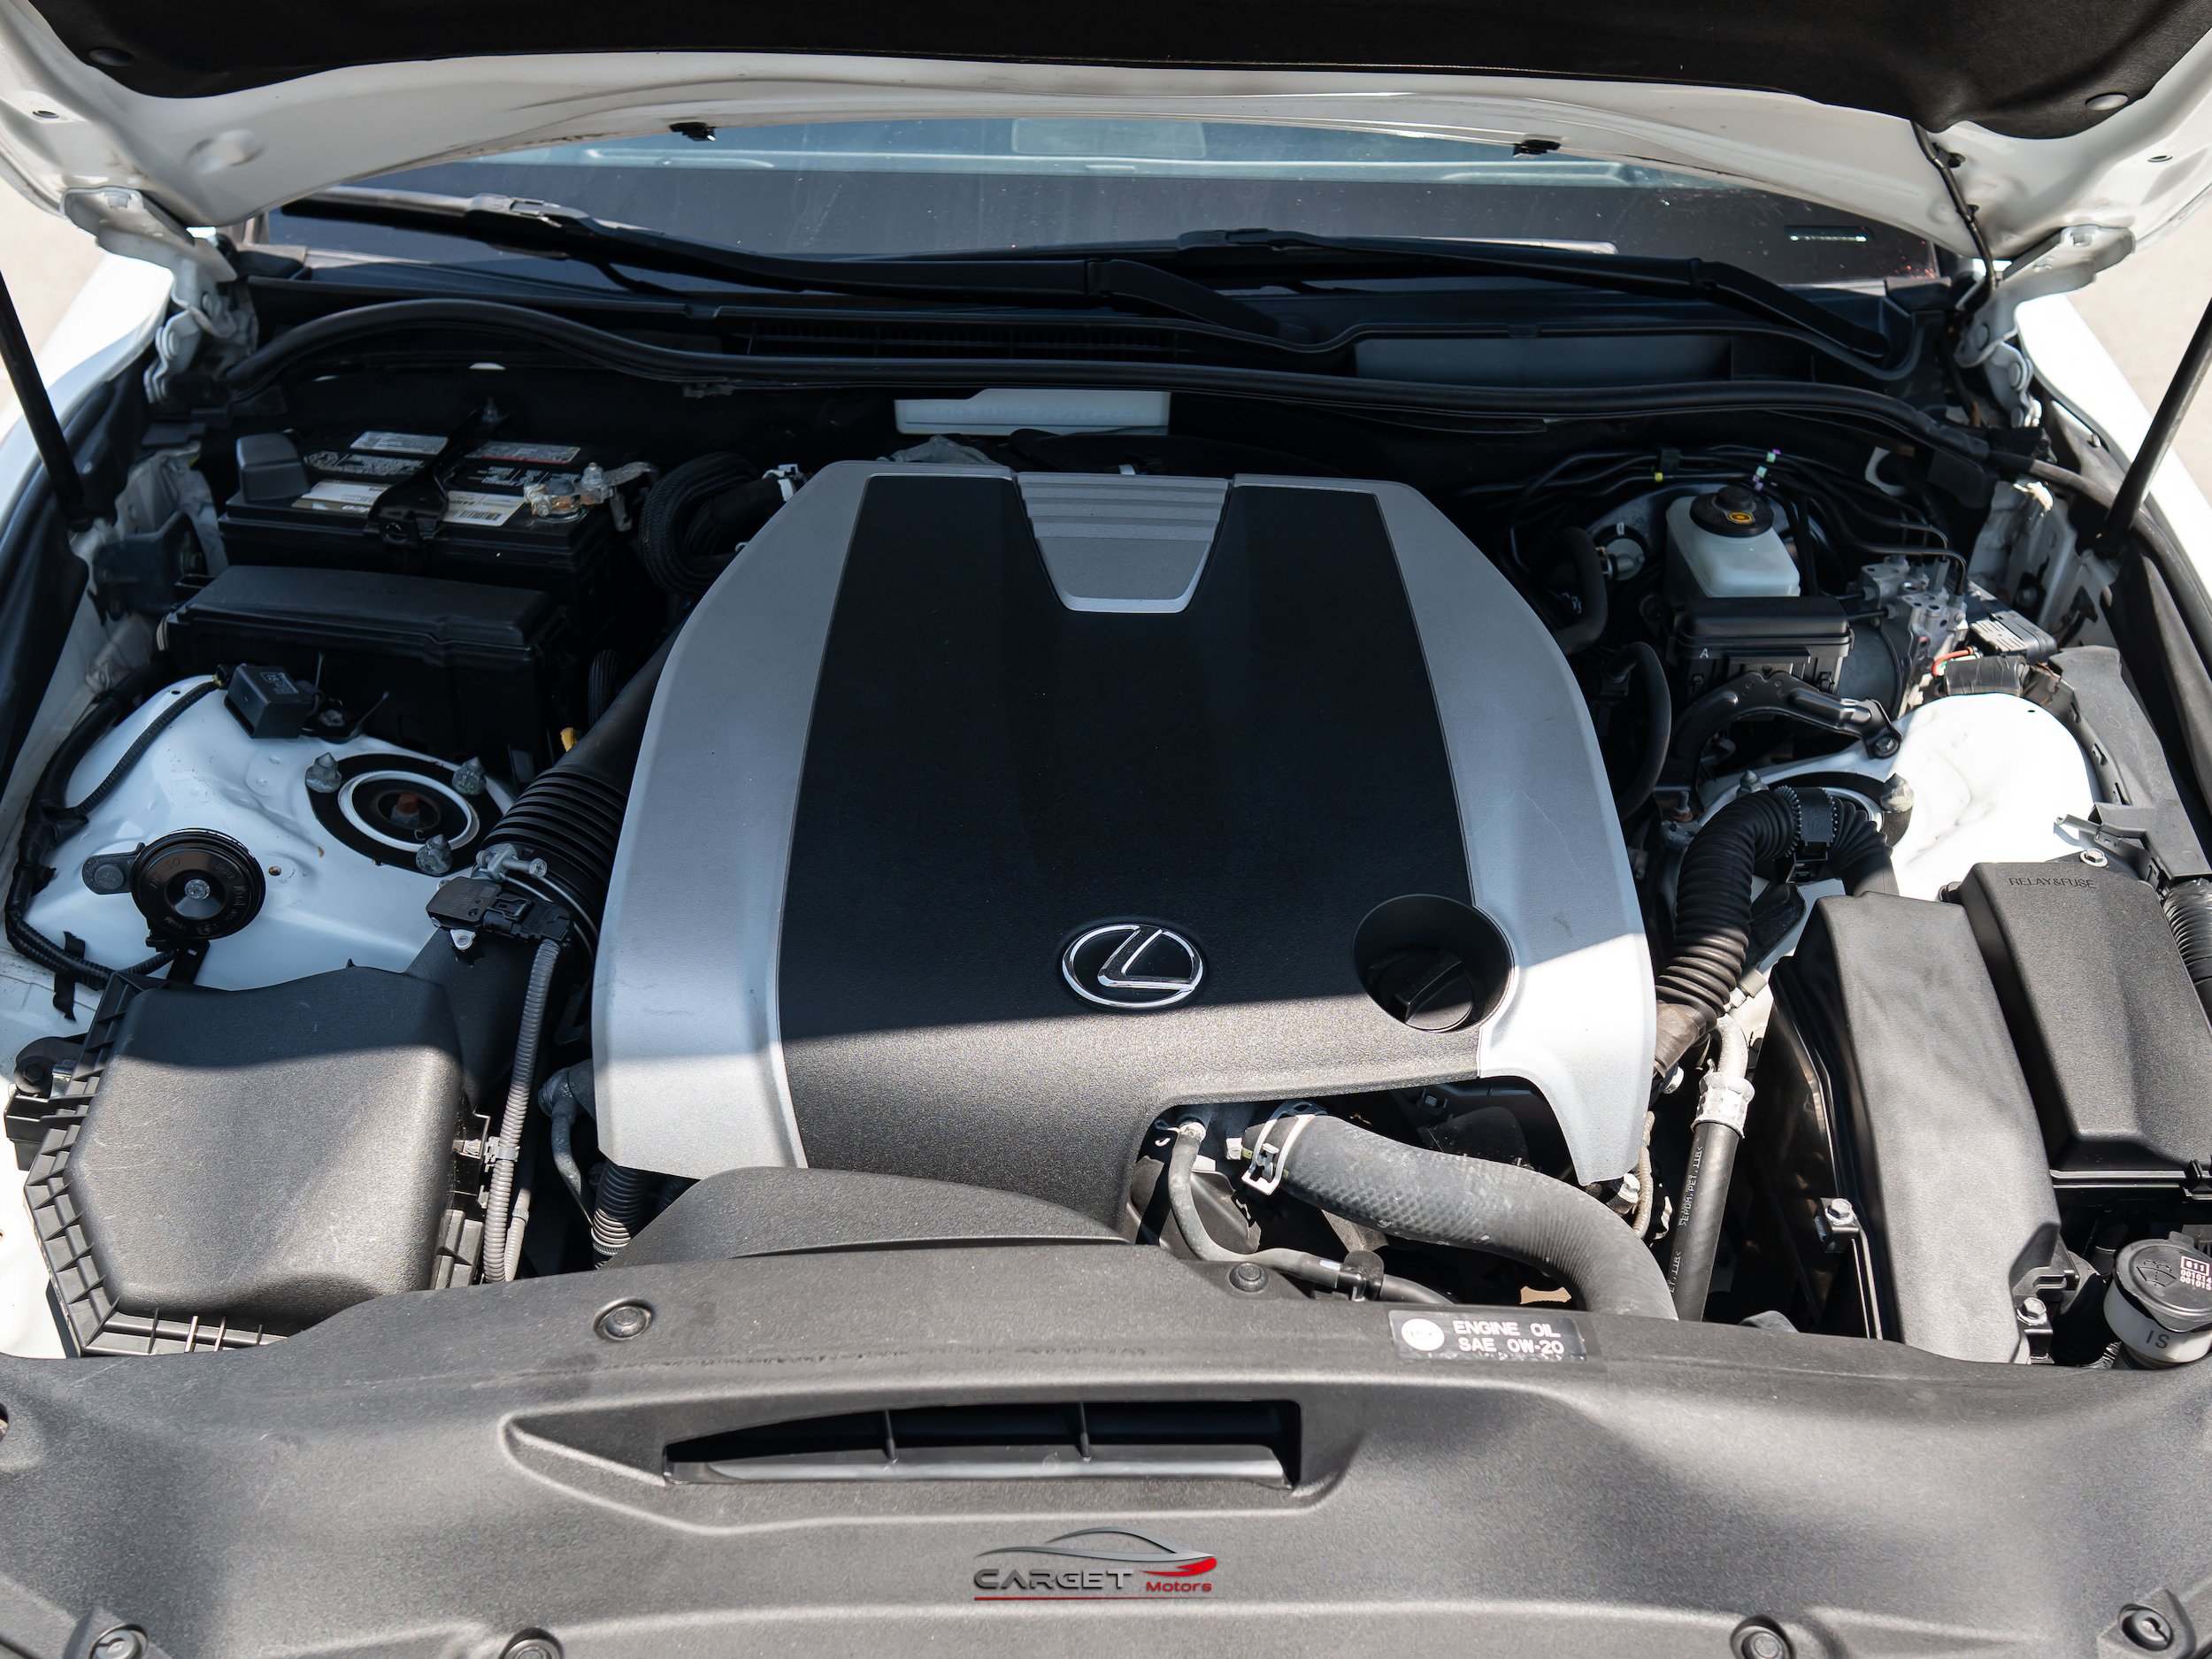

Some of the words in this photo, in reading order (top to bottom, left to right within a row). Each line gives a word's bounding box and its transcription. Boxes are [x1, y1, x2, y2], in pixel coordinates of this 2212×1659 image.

[2008, 877, 2096, 889] RELAY&FUSE
[2179, 1275, 2212, 1291] 001015
[2180, 1269, 2212, 1285] 001014
[1452, 1319, 1521, 1336] ENGINE
[1530, 1323, 1562, 1338] OIL
[1457, 1337, 1497, 1353] SAE
[1507, 1338, 1565, 1355] 0W-20
